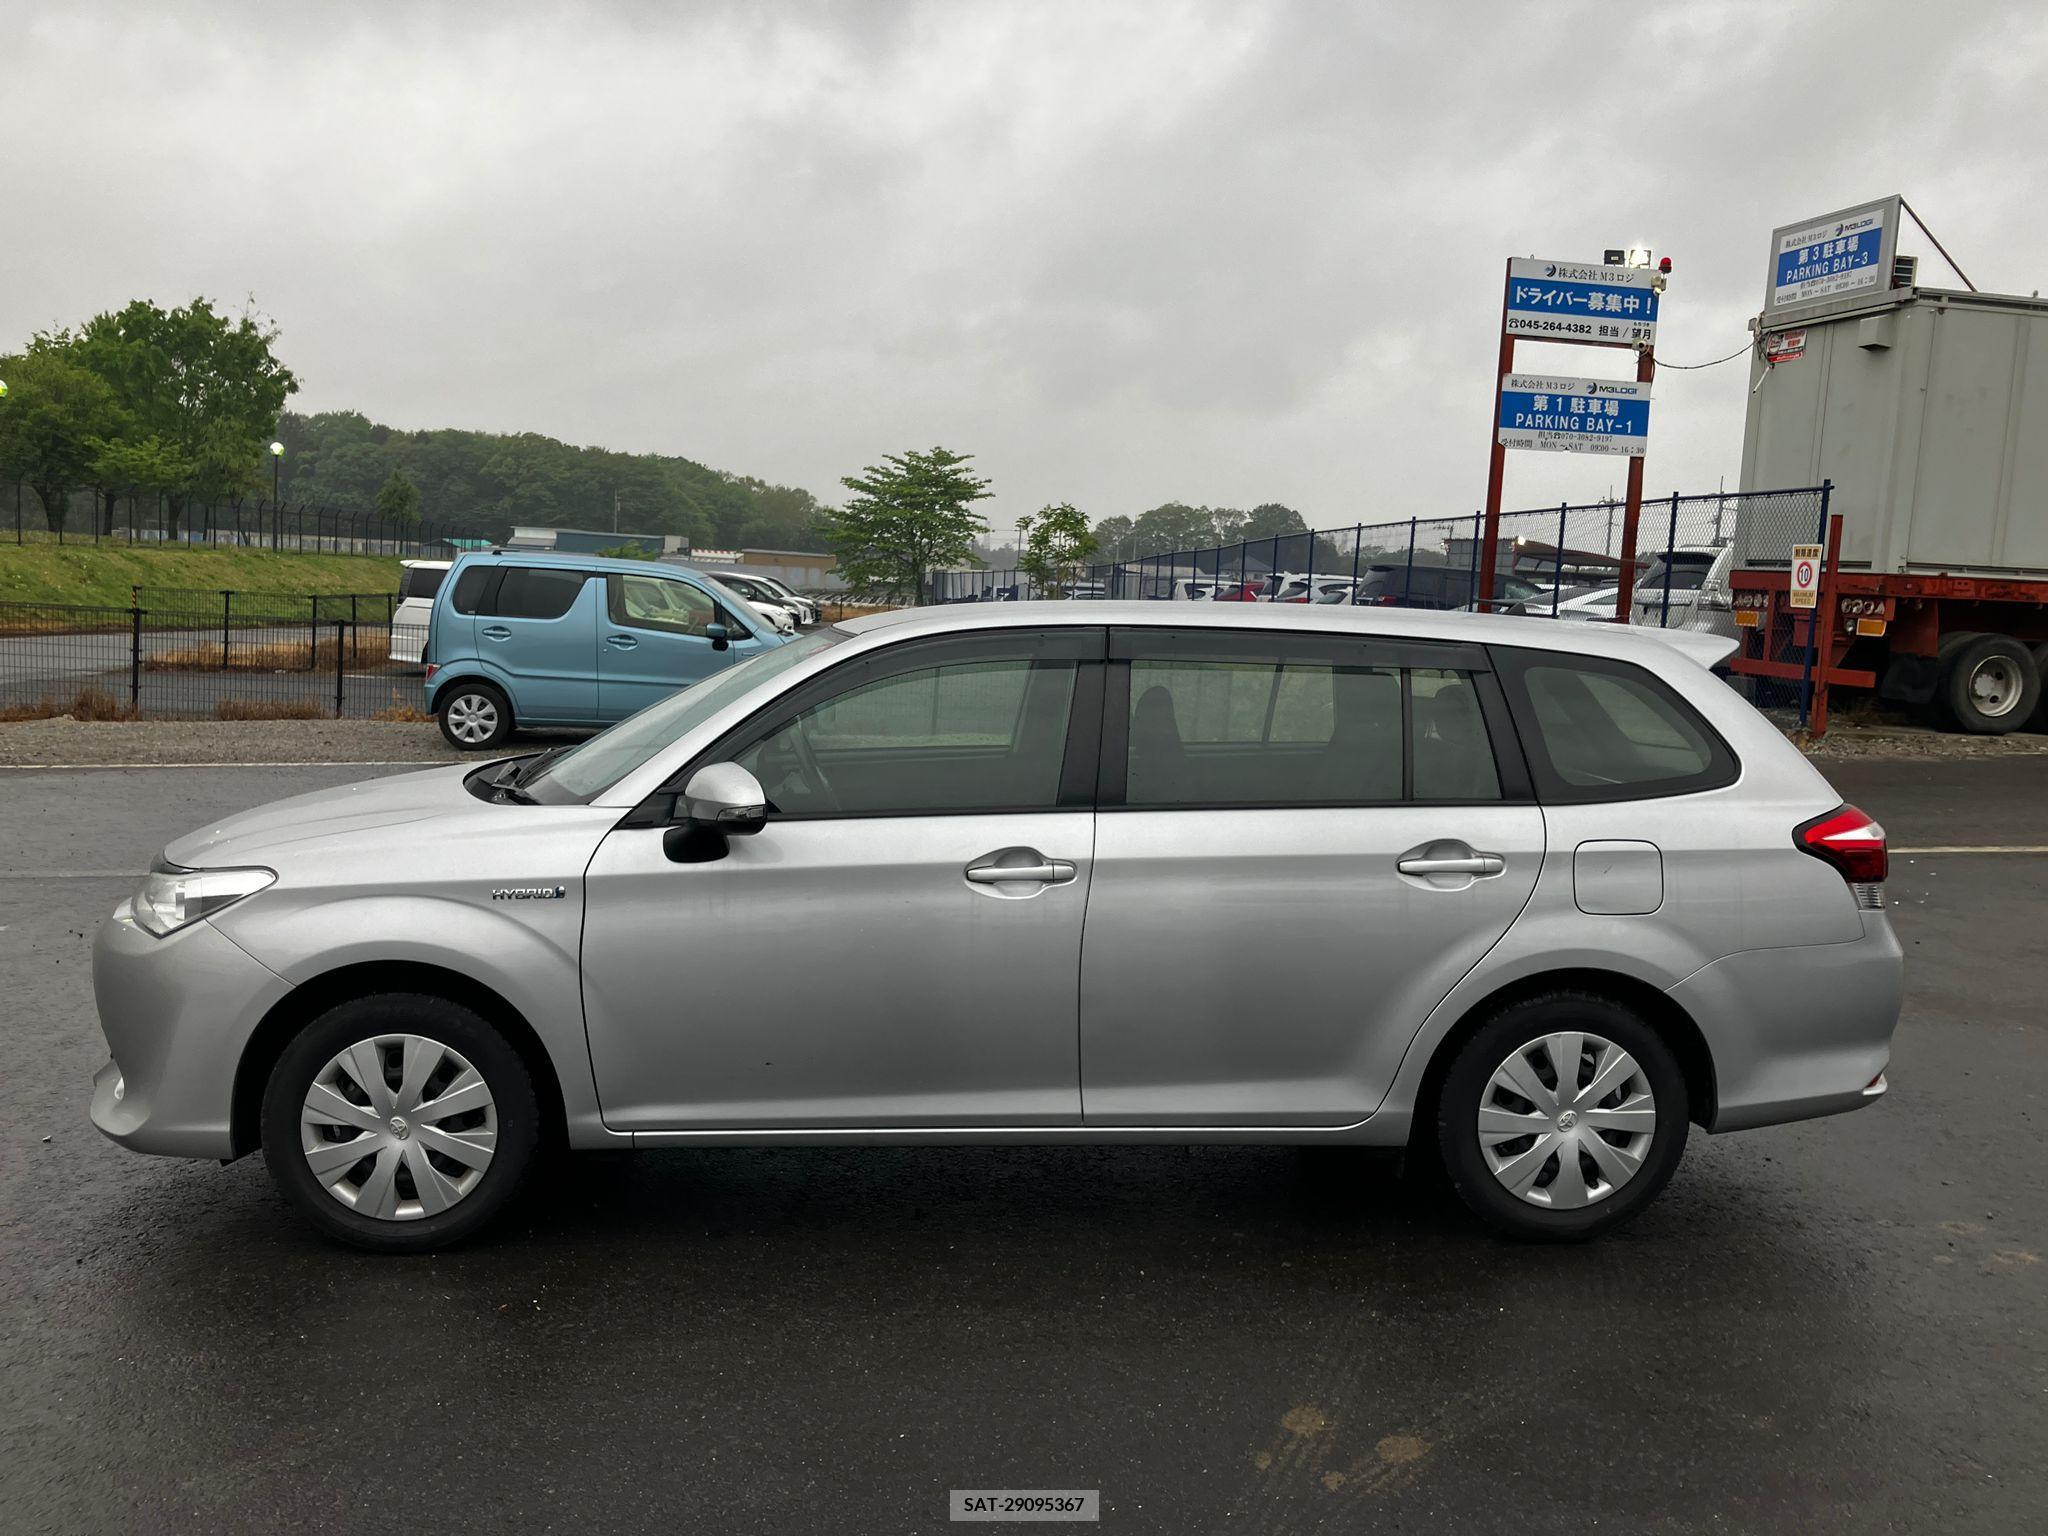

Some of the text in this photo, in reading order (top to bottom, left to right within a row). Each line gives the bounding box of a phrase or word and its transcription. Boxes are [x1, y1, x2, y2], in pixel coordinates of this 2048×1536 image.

[1786, 261, 1829, 283] PARKING
[1833, 251, 1868, 272] BAY-3
[1519, 318, 1592, 334] 045-264-4382
[1599, 385, 1637, 395] M3LOGI
[1515, 413, 1632, 433] PARKING BAY-1
[1540, 441, 1557, 449] MON
[1568, 442, 1583, 451] SAT
[1800, 568, 1809, 582] 10
[492, 888, 553, 900] HYBRID
